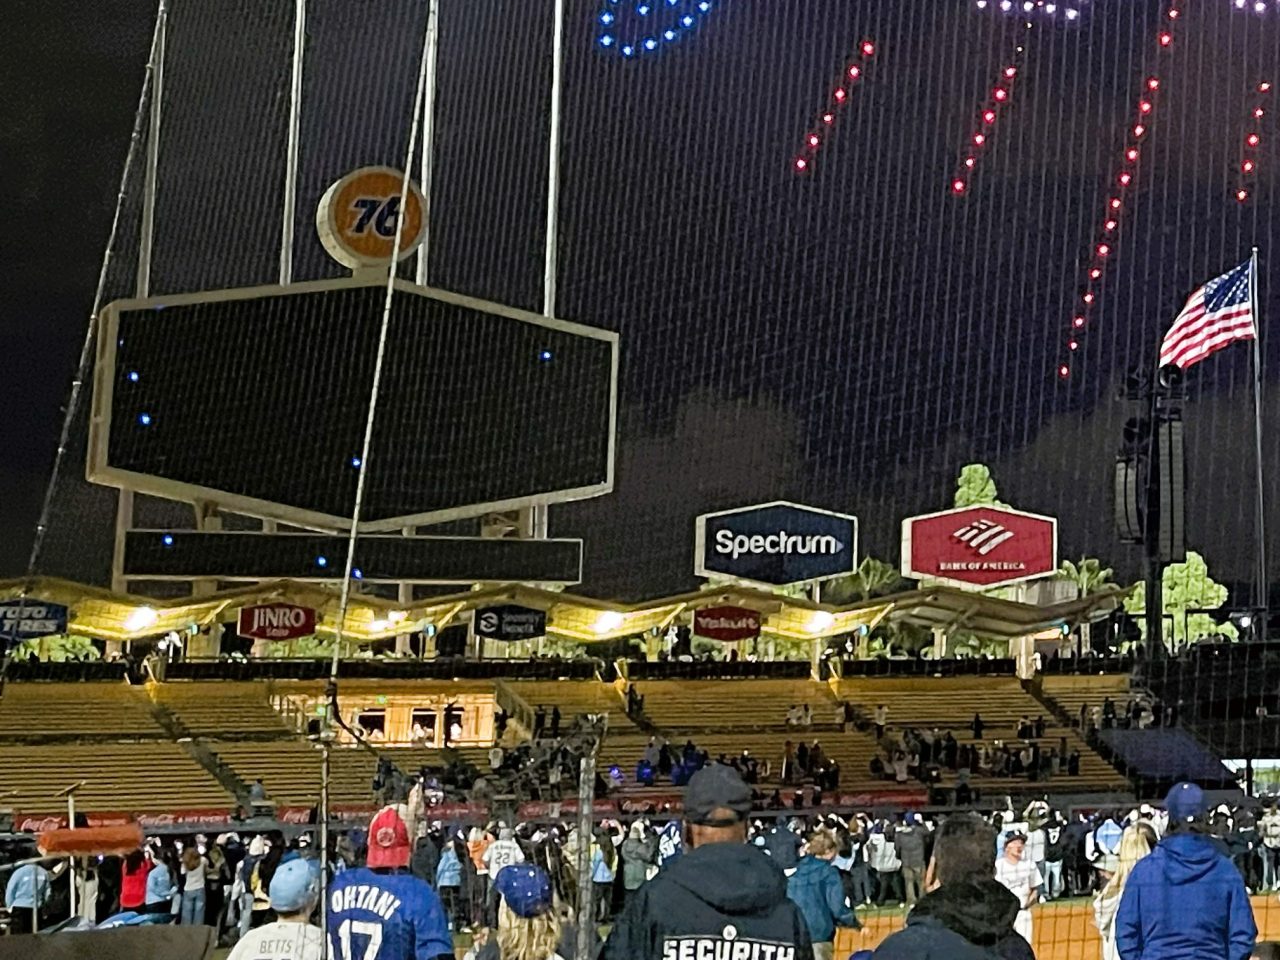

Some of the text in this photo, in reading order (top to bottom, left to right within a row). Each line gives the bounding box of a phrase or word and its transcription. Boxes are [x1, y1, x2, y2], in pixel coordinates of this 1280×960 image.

[349, 194, 406, 239] 76
[715, 529, 836, 559] Spectrum
[3, 620, 58, 632] TIRES
[250, 608, 306, 633] JINRO
[697, 617, 759, 629] Yakult
[495, 852, 510, 865] 22
[331, 885, 401, 921] OHTANI
[259, 940, 292, 954] BETTS
[338, 919, 382, 960] 17
